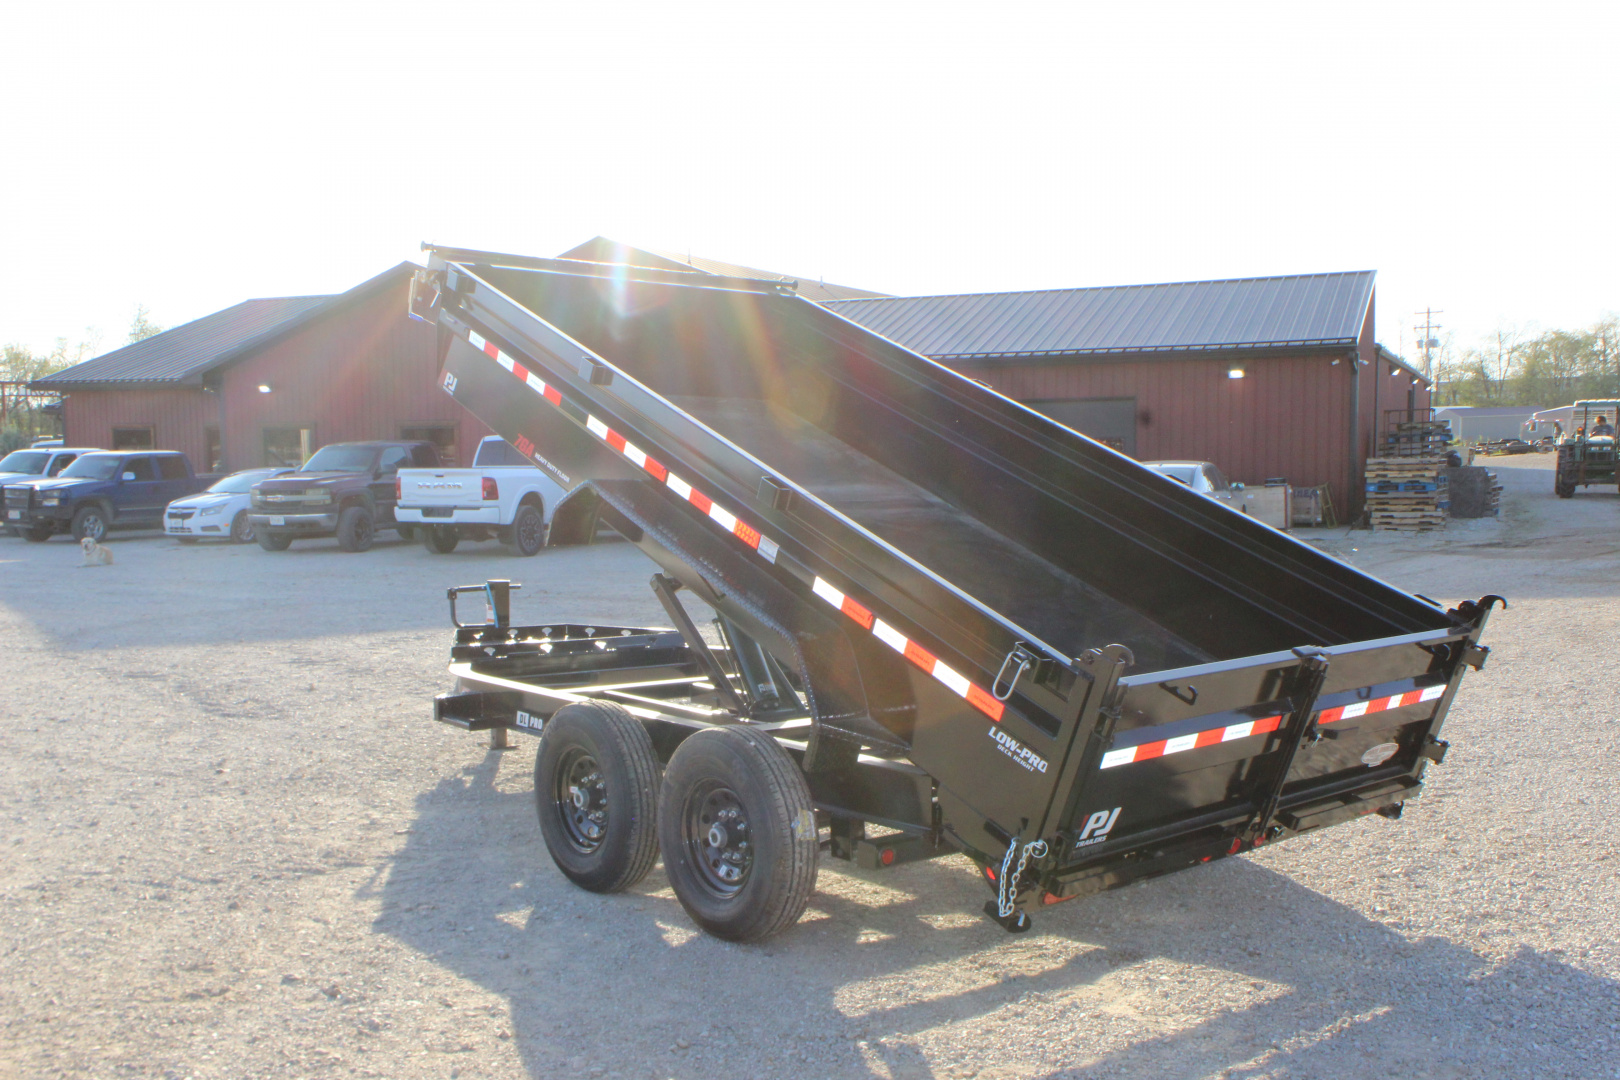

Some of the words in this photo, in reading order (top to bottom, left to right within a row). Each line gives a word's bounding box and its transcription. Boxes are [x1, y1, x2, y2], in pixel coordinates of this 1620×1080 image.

[444, 371, 458, 391] PJ
[534, 452, 548, 466] HEAVY
[546, 461, 558, 474] DUTY
[556, 469, 570, 483] FLOOR
[529, 716, 543, 730] PRO
[988, 726, 1048, 773] LOW-PRO
[997, 744, 1012, 757] DECK
[1012, 755, 1035, 772] HEIGHT
[1079, 806, 1122, 840] PJ
[1075, 835, 1107, 848] TRAILERS
